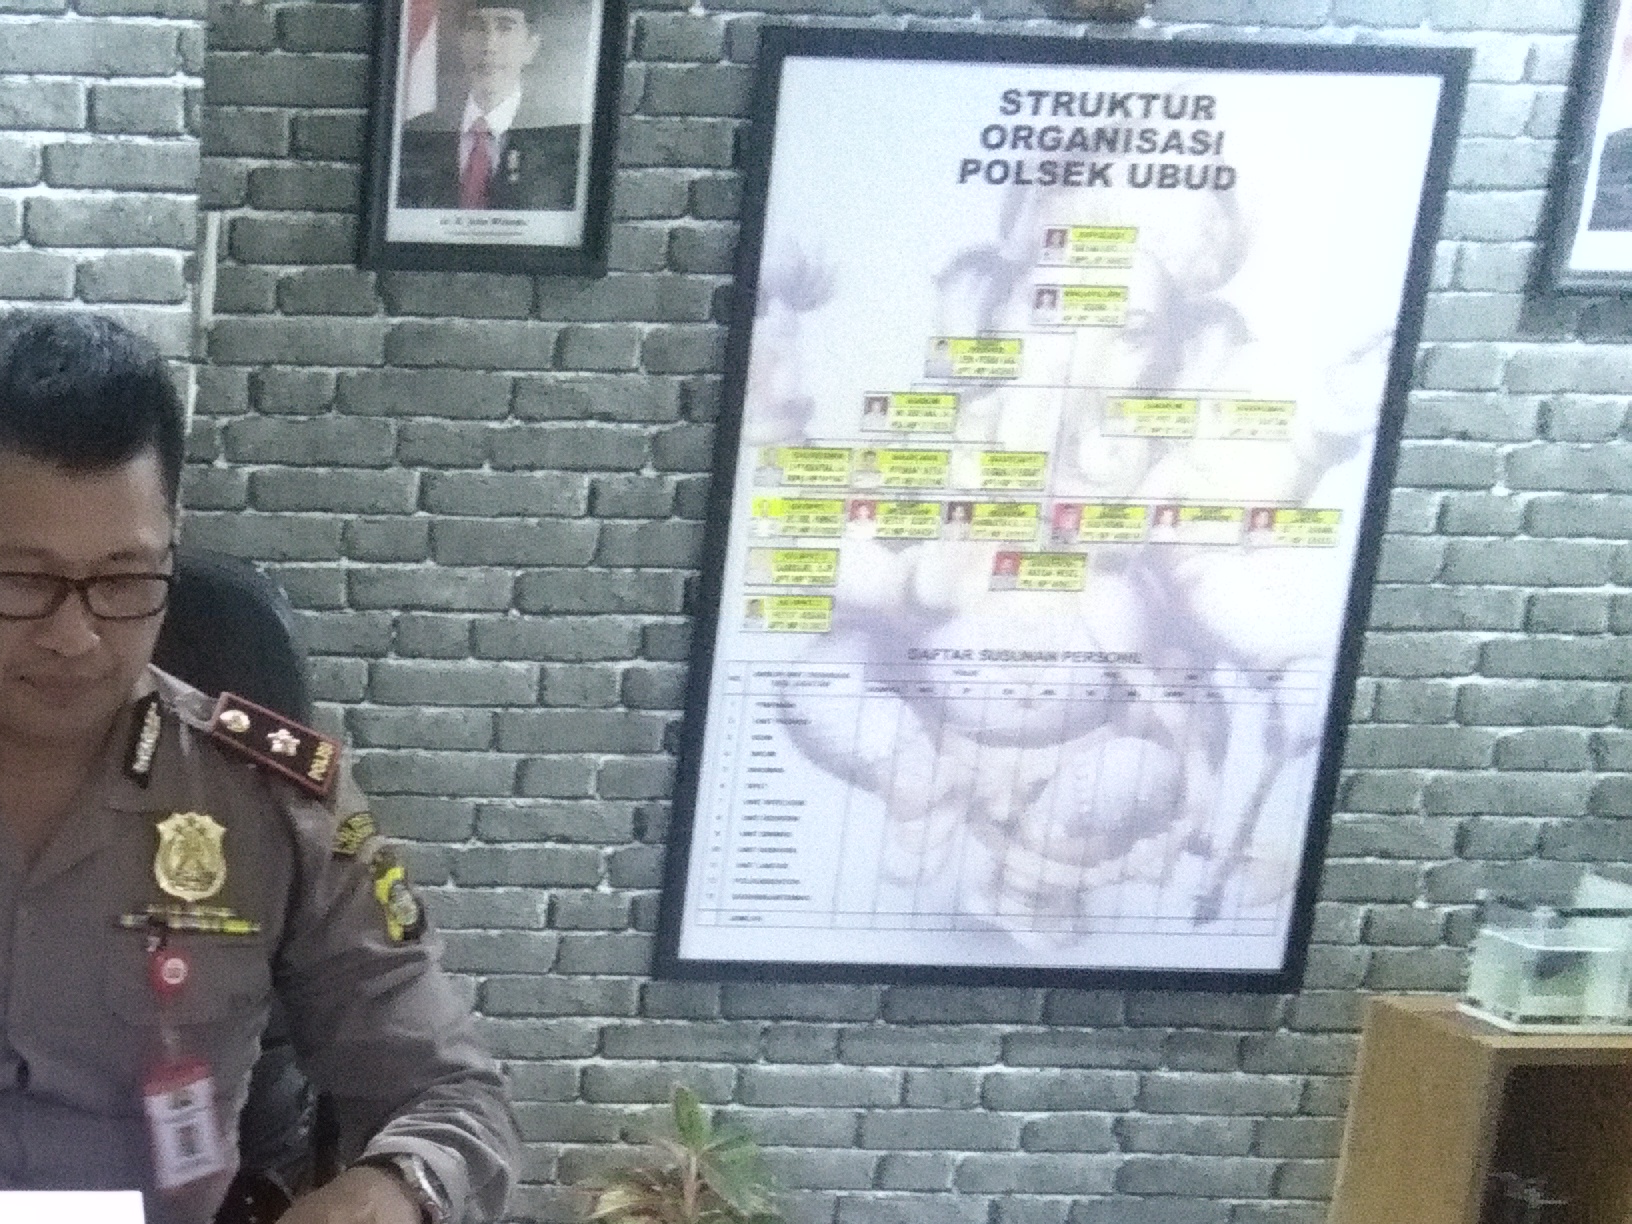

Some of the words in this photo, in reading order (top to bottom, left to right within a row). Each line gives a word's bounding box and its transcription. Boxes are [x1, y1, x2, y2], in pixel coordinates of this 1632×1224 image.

[999, 88, 1217, 121] STRUKTUR
[980, 124, 1226, 156] ORGANISASI
[956, 157, 1114, 188] POLSEK
[1127, 162, 1238, 191] UBUD
